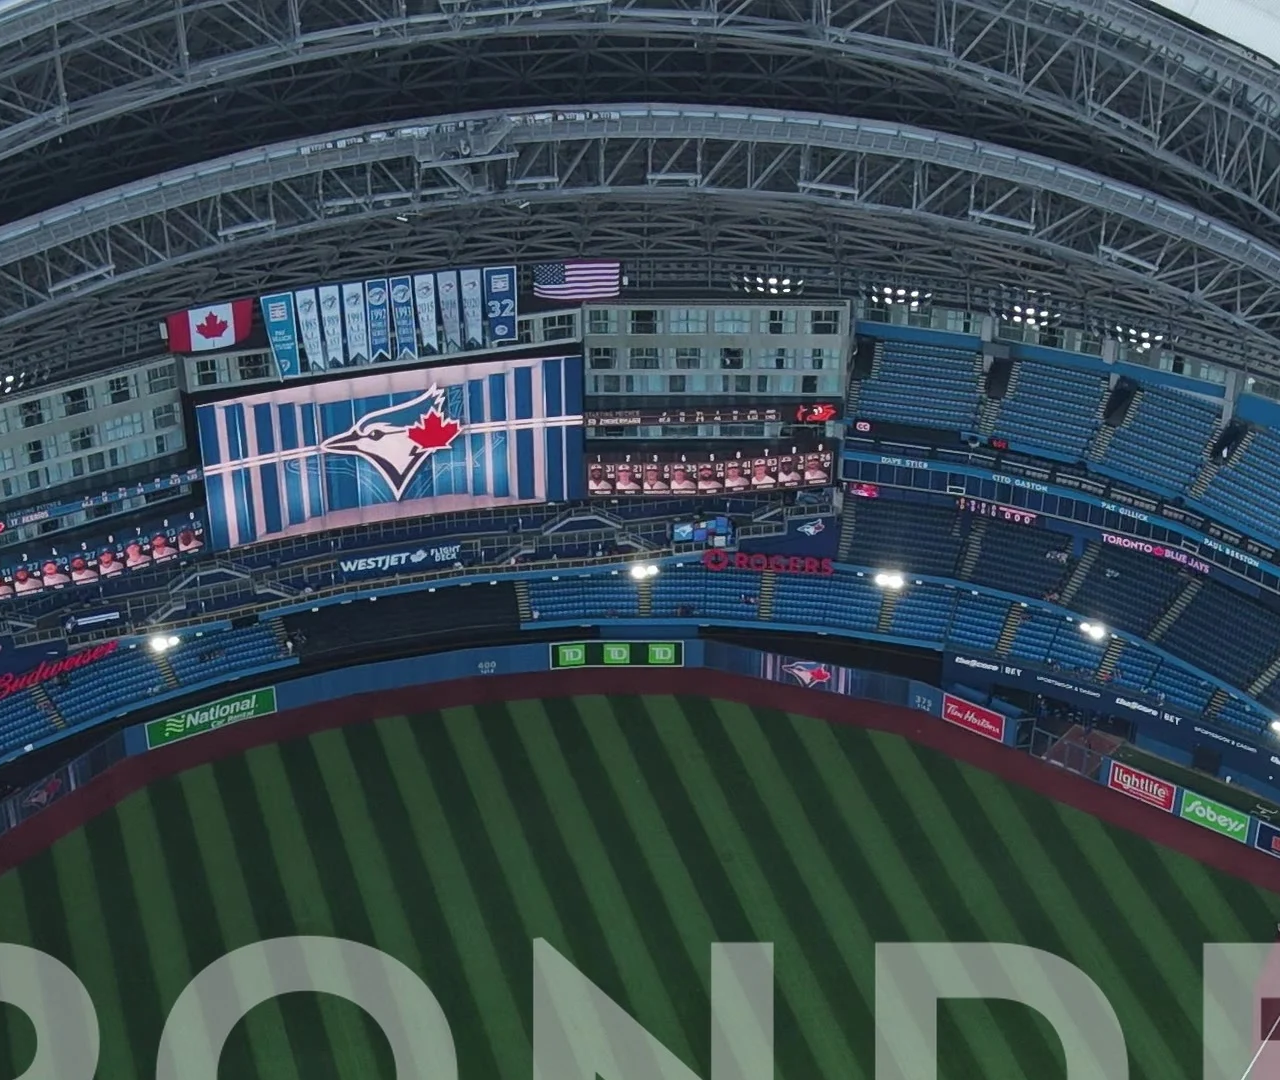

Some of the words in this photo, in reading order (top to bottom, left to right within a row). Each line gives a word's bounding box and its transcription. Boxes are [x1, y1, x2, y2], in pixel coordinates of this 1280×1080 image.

[488, 299, 514, 318] 32
[606, 464, 615, 473] 31
[1015, 479, 1048, 492] GASTON
[1119, 507, 1149, 522] GILLICK
[430, 545, 461, 557] FLIGHT
[434, 553, 457, 562] DECK
[1102, 533, 1153, 553] TORONTO
[1164, 549, 1188, 564] BLUE
[1188, 558, 1211, 574] JAYS
[340, 552, 411, 573] WESTJET
[735, 552, 834, 576] ROGERS
[563, 648, 582, 662] TD
[606, 647, 628, 660] TD
[650, 647, 671, 660] TD
[477, 660, 497, 669] 400
[185, 694, 257, 729] National
[946, 702, 963, 719] Tim
[962, 708, 1000, 734] Hortons
[1163, 712, 1183, 726] BET
[1185, 799, 1246, 833] Sobeys
